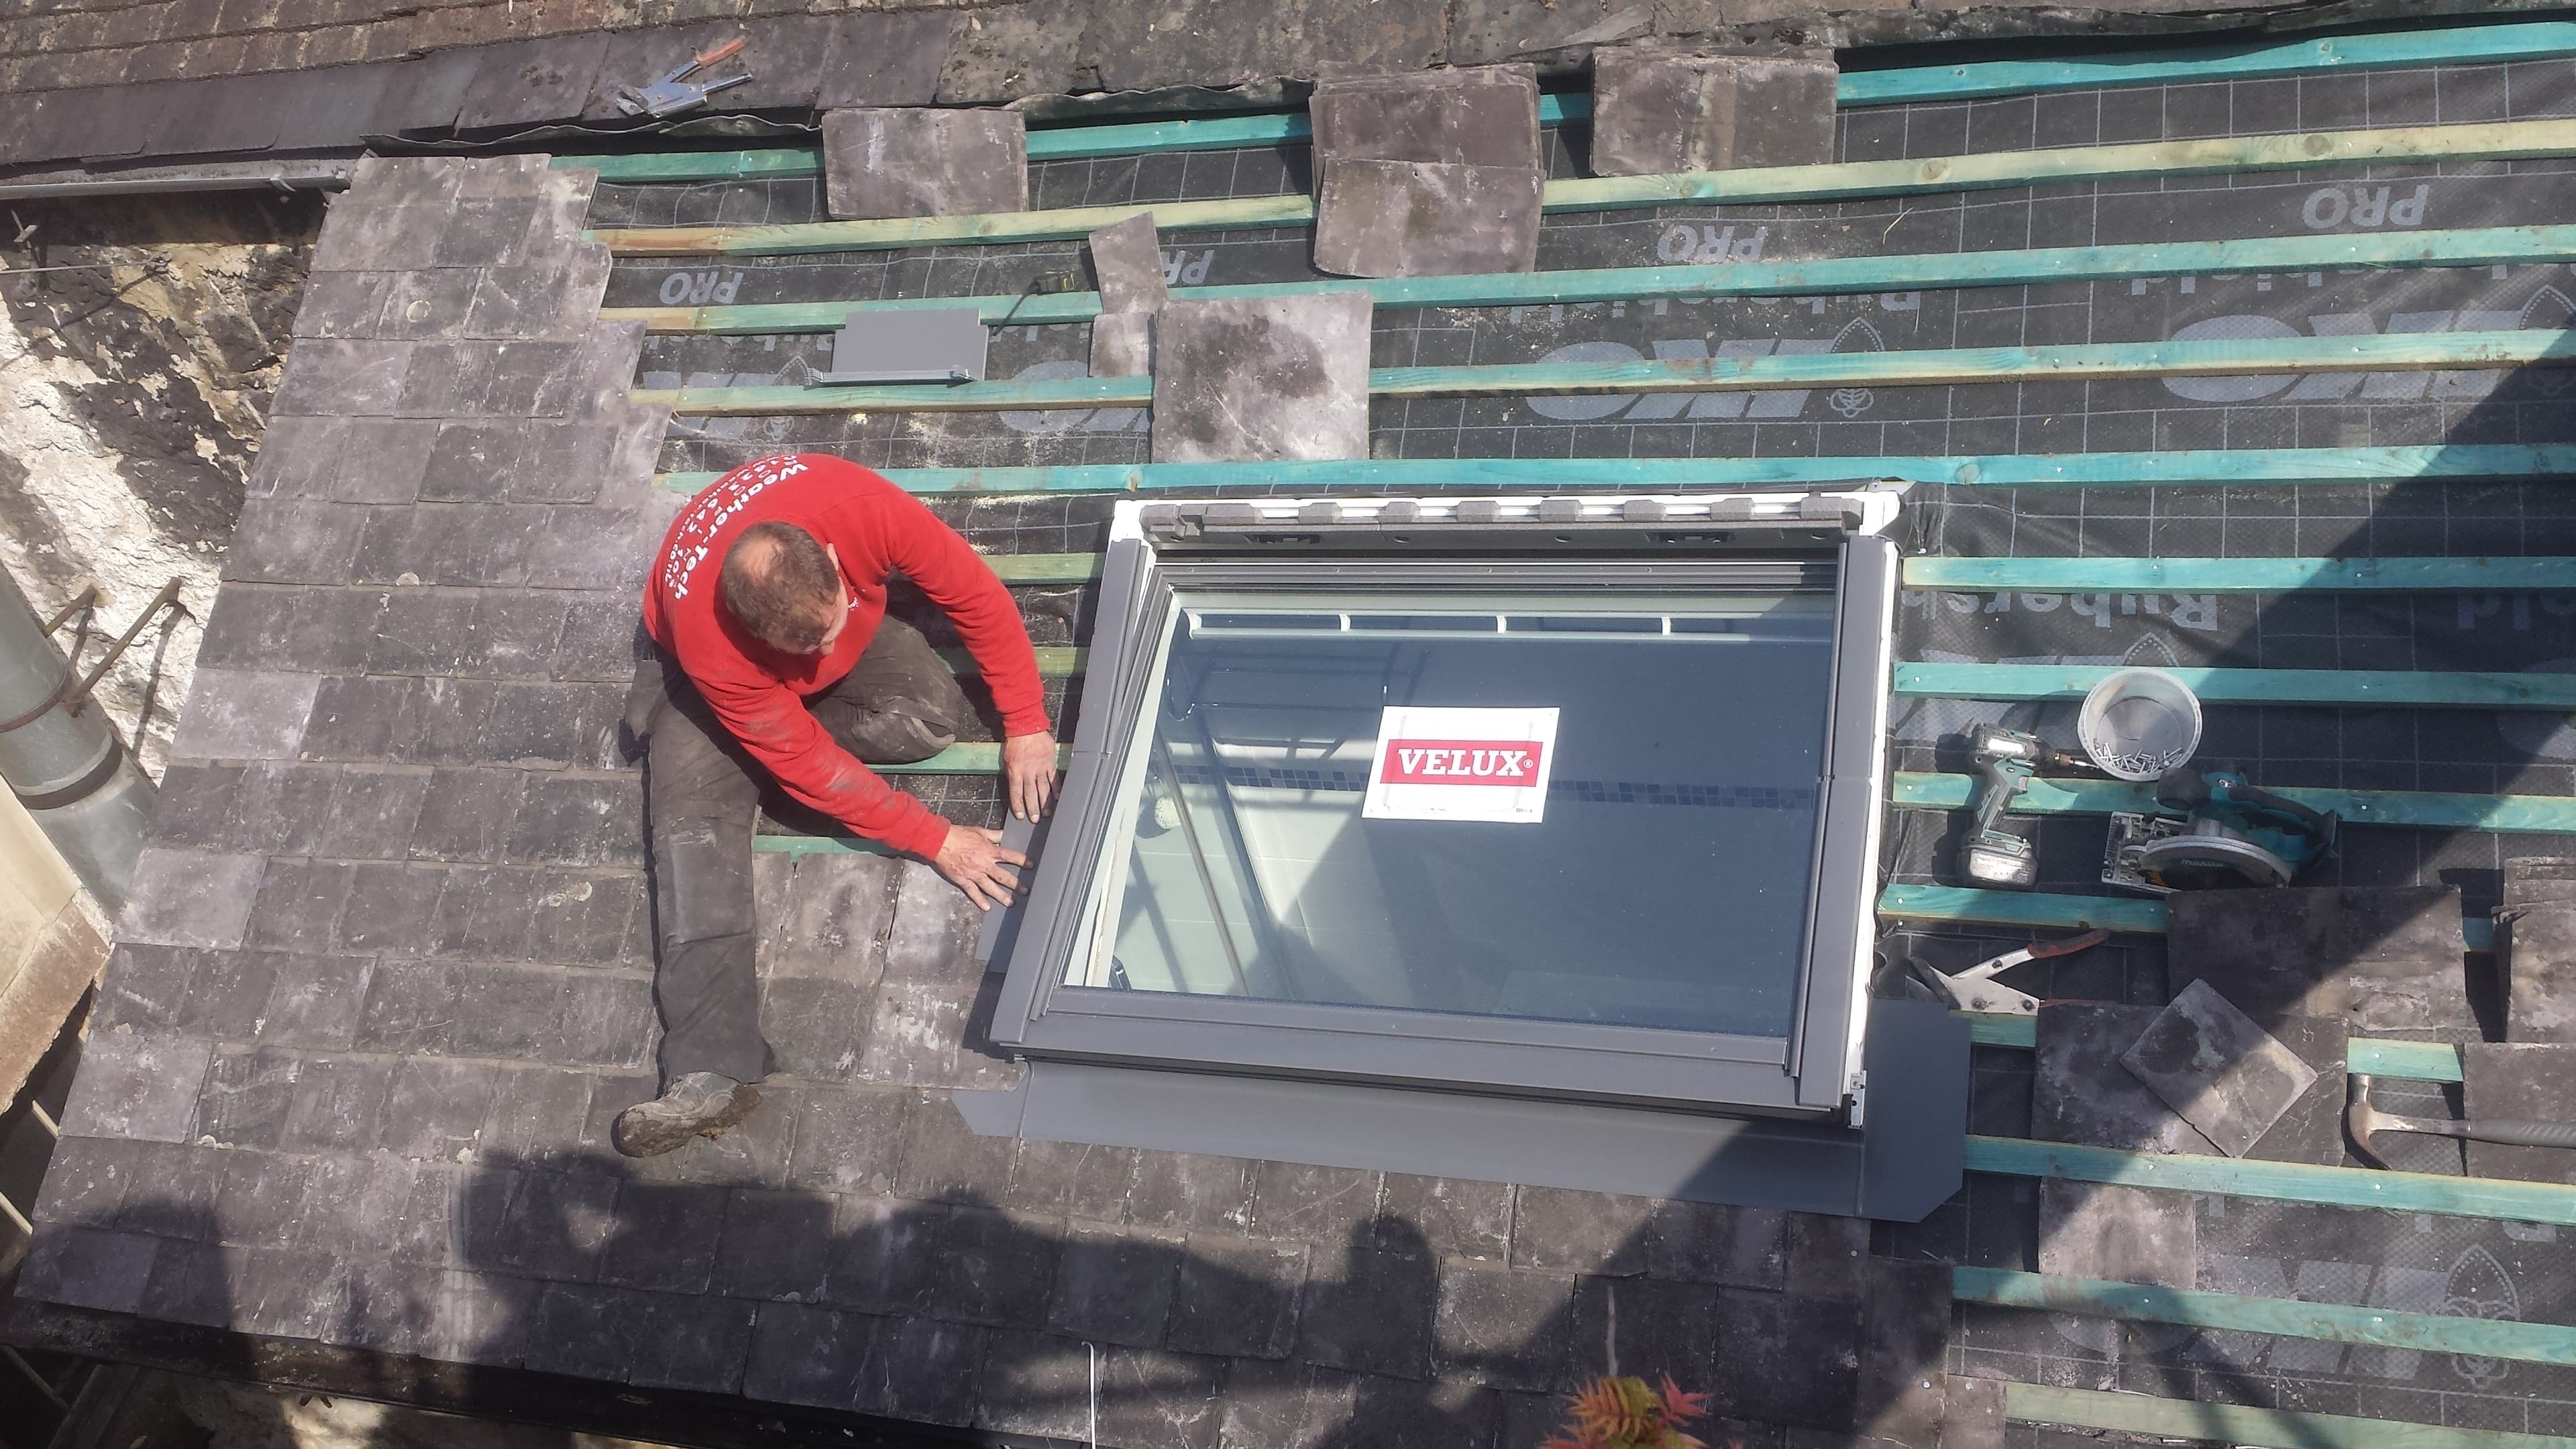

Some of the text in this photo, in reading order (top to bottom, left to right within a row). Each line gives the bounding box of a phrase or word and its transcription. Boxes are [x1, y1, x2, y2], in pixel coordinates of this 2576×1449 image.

[2302, 184, 2430, 229] PRO
[1656, 225, 1768, 263] PRO
[1162, 250, 1215, 284] PR
[659, 271, 745, 305] PRO
[674, 463, 809, 600] Weather-Tech
